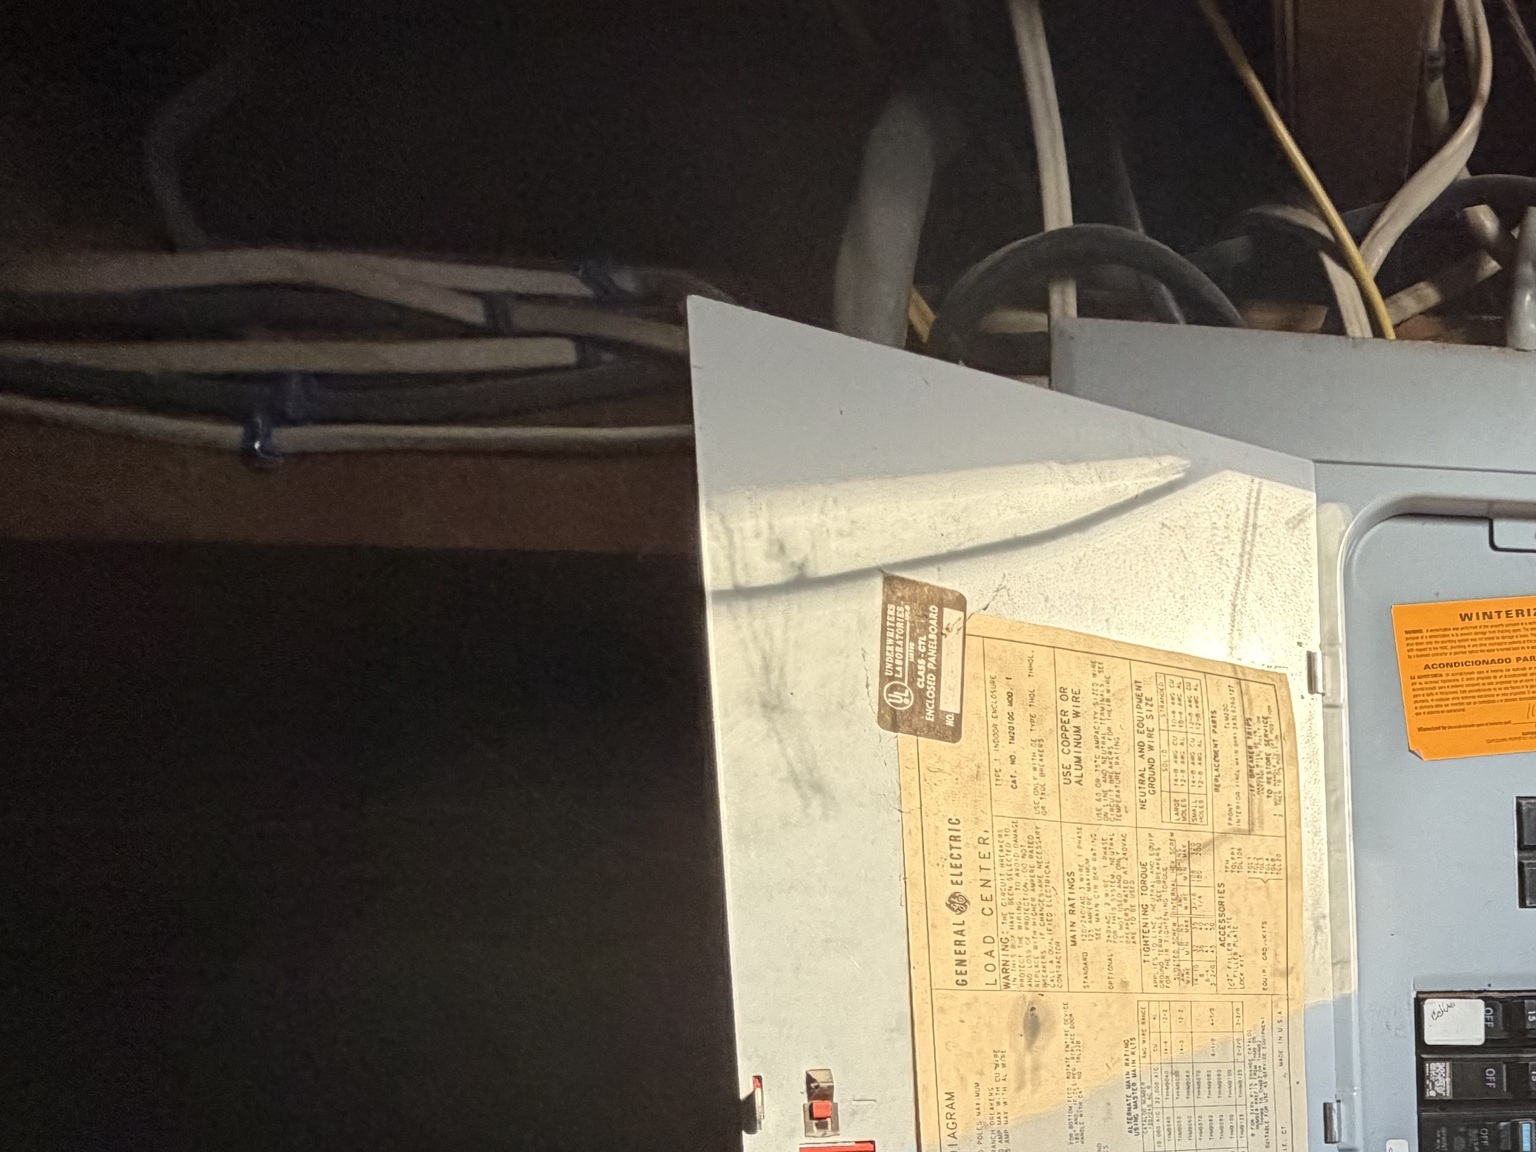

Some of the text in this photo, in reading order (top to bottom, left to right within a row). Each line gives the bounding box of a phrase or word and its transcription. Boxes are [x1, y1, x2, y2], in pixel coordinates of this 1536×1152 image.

[885, 604, 895, 676] UNDERWRITERS
[926, 606, 938, 722] ENCLOSED PANELBOARD
[1423, 656, 1512, 671] ACONDICIONADO
[990, 674, 998, 719] ENCLOSURE
[1059, 686, 1072, 785] USE COPPER OR
[1071, 688, 1083, 786] ALUMINUM WIRE
[1092, 710, 1100, 750] AMPACITY
[1210, 710, 1218, 734] PARTS
[1134, 680, 1147, 810] NEUTRAL AND EQUIPMENT
[1144, 696, 1156, 796] GROUND WIRE SIZE
[1246, 745, 1255, 779] BREAKER
[1264, 752, 1272, 784] RESTORE
[1034, 826, 1042, 870] NECESSARY
[1028, 863, 1036, 893] AMPERE
[948, 818, 968, 986] GENERAL ELECTRIC
[1066, 871, 1077, 946] MAIN RATINGS
[1140, 861, 1151, 964] TIGHTENING TORQUE
[1218, 882, 1226, 948] ACCESSORIES
[983, 935, 997, 986] LOAD
[1106, 954, 1114, 990] OPTIONAL
[1484, 1007, 1494, 1028] OFF
[1528, 1010, 1536, 1022] 15
[1278, 1036, 1282, 1045] IN
[1485, 1068, 1496, 1088] OFF
[1124, 1069, 1134, 1134] ALTERNATE MAIN
[1281, 1126, 1288, 1134] CT
[1480, 1128, 1489, 1146] OFF
